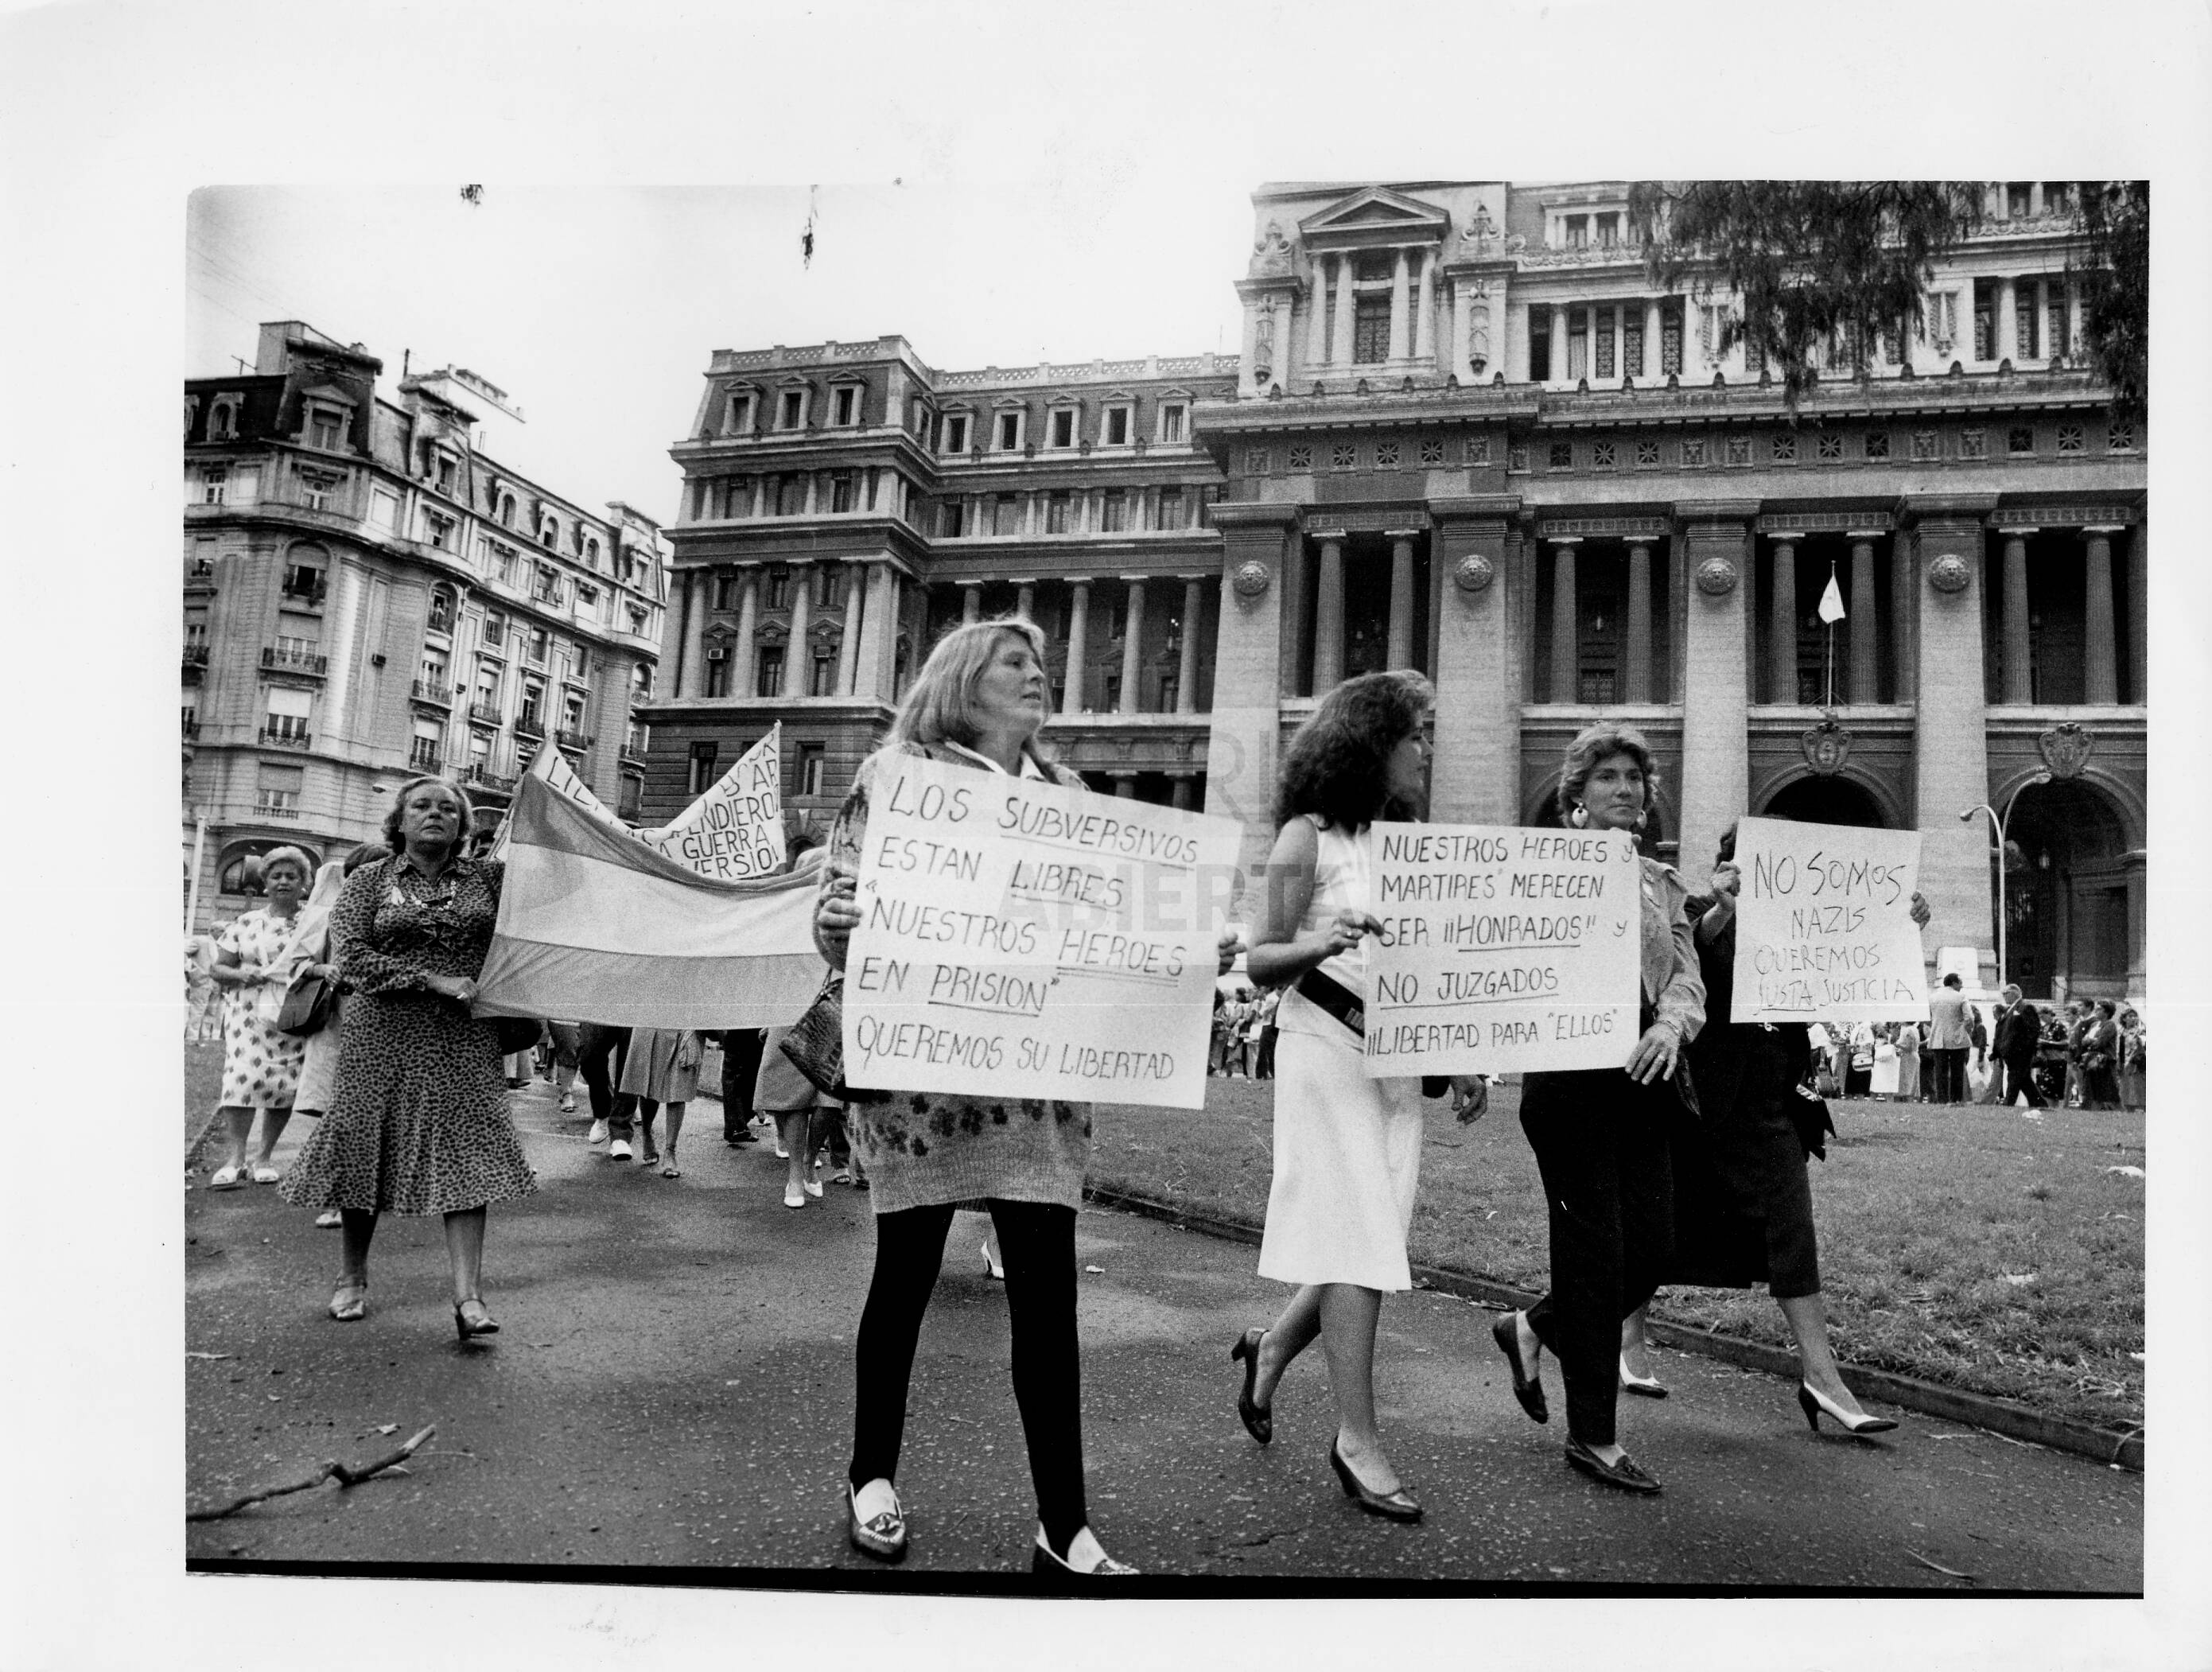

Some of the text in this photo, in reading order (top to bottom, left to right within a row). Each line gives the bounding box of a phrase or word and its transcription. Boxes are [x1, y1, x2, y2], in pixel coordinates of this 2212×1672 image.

[889, 776, 1199, 863] LOS SUBVERSIVOS
[682, 824, 770, 860] GUERRA
[1382, 834, 1509, 863] NUESTROS
[694, 845, 779, 879] ERSIO
[878, 837, 1124, 908] ESTAN LIBRES
[1755, 850, 1907, 906] NO SOMOS
[1510, 873, 1604, 899] MERECEN
[1380, 917, 1430, 947] SER
[1792, 906, 1867, 940] NAZIS
[1058, 928, 1187, 977] HEROES
[1754, 943, 1882, 975] QUEREMOS
[859, 957, 910, 992] EN
[1377, 967, 1559, 1004] NO JUZGADOS
[1752, 977, 1915, 1016] JUSTA JUSTICIA
[857, 1015, 1175, 1080] QUEREMOS SU LIBERTAD
[1492, 1021, 1538, 1048] PARA
